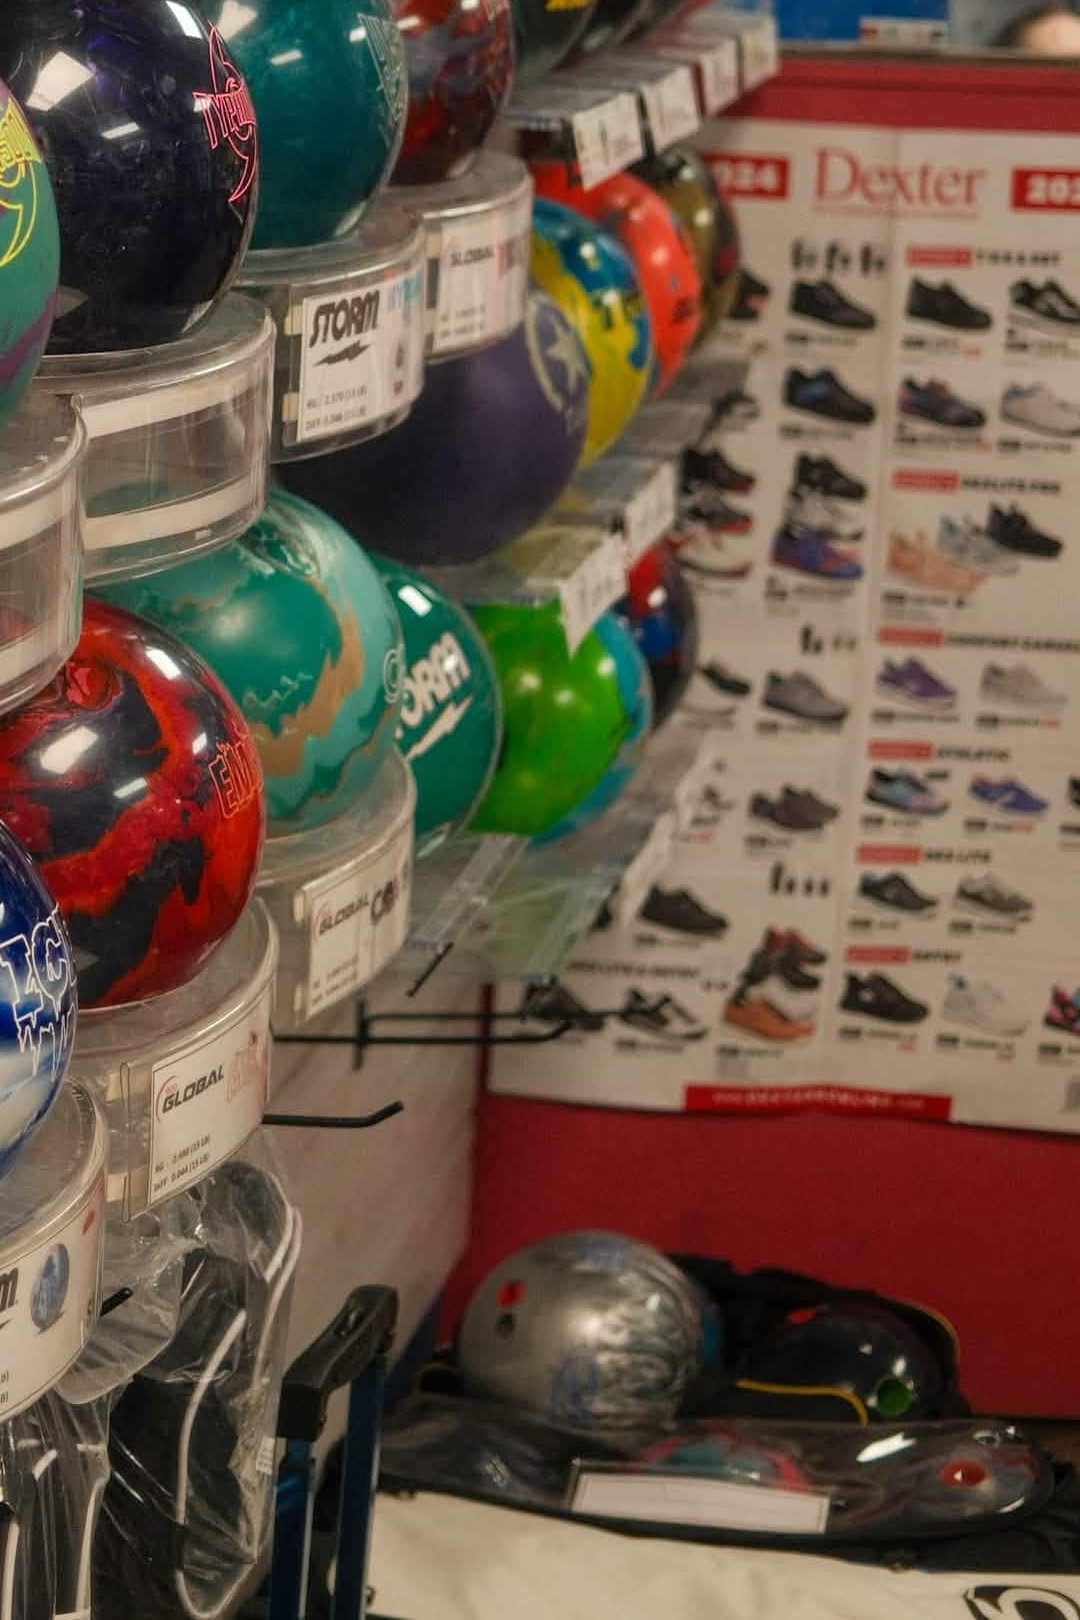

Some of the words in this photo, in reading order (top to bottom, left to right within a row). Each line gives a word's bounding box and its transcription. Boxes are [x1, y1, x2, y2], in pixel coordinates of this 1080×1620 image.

[816, 147, 986, 206] Dexter
[308, 290, 380, 348] STORM
[162, 1065, 225, 1114] GLOBAL
